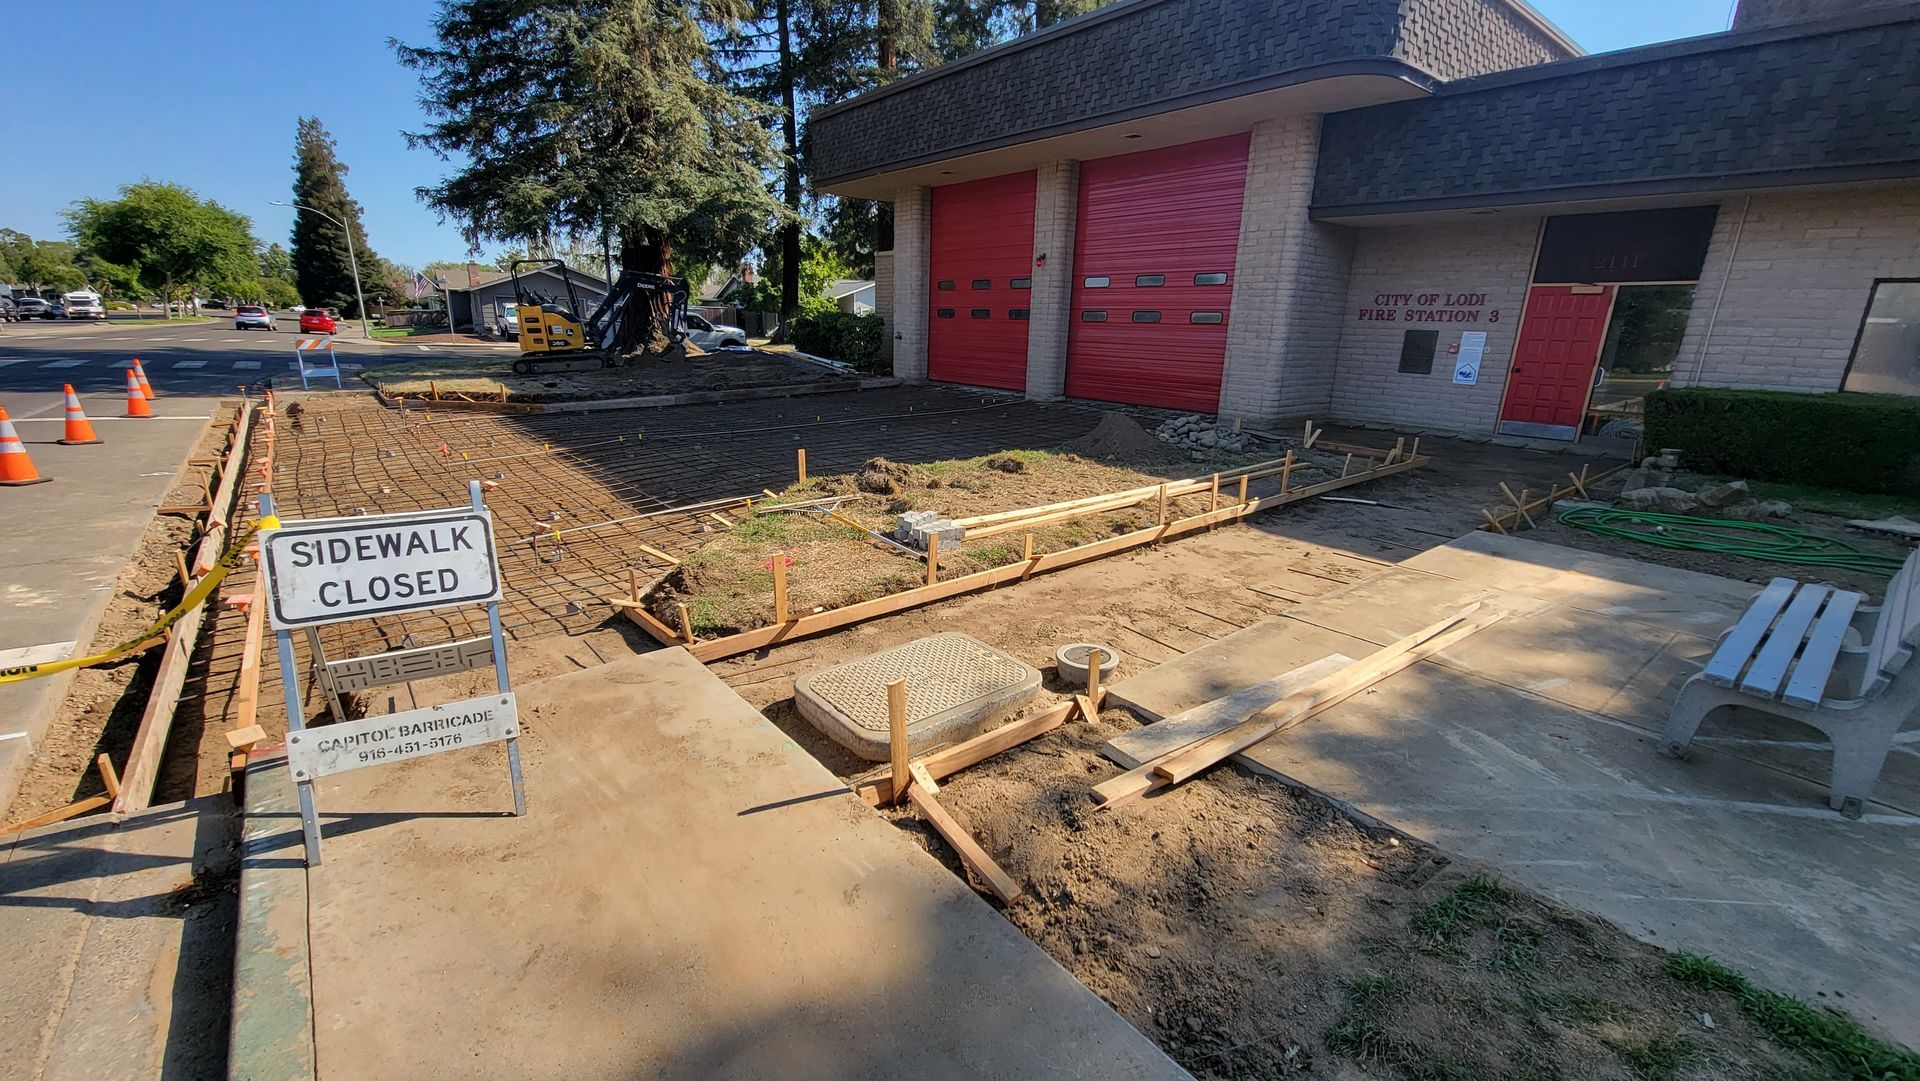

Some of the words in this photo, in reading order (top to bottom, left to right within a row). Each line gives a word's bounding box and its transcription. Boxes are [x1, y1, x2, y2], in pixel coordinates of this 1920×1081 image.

[637, 282, 655, 290] DEERE
[1375, 294, 1412, 306] CITY
[1418, 294, 1439, 305] OF
[1445, 294, 1488, 306] LODI
[1358, 309, 1396, 321] FIRE
[1405, 310, 1479, 322] STATION
[1489, 310, 1500, 322] 3
[290, 526, 473, 568] SIDEWALK
[318, 568, 459, 608] CLOSED
[317, 727, 395, 753] CAPITOL
[400, 710, 494, 737] BARRICADE
[359, 733, 462, 762] 916-451-5176
